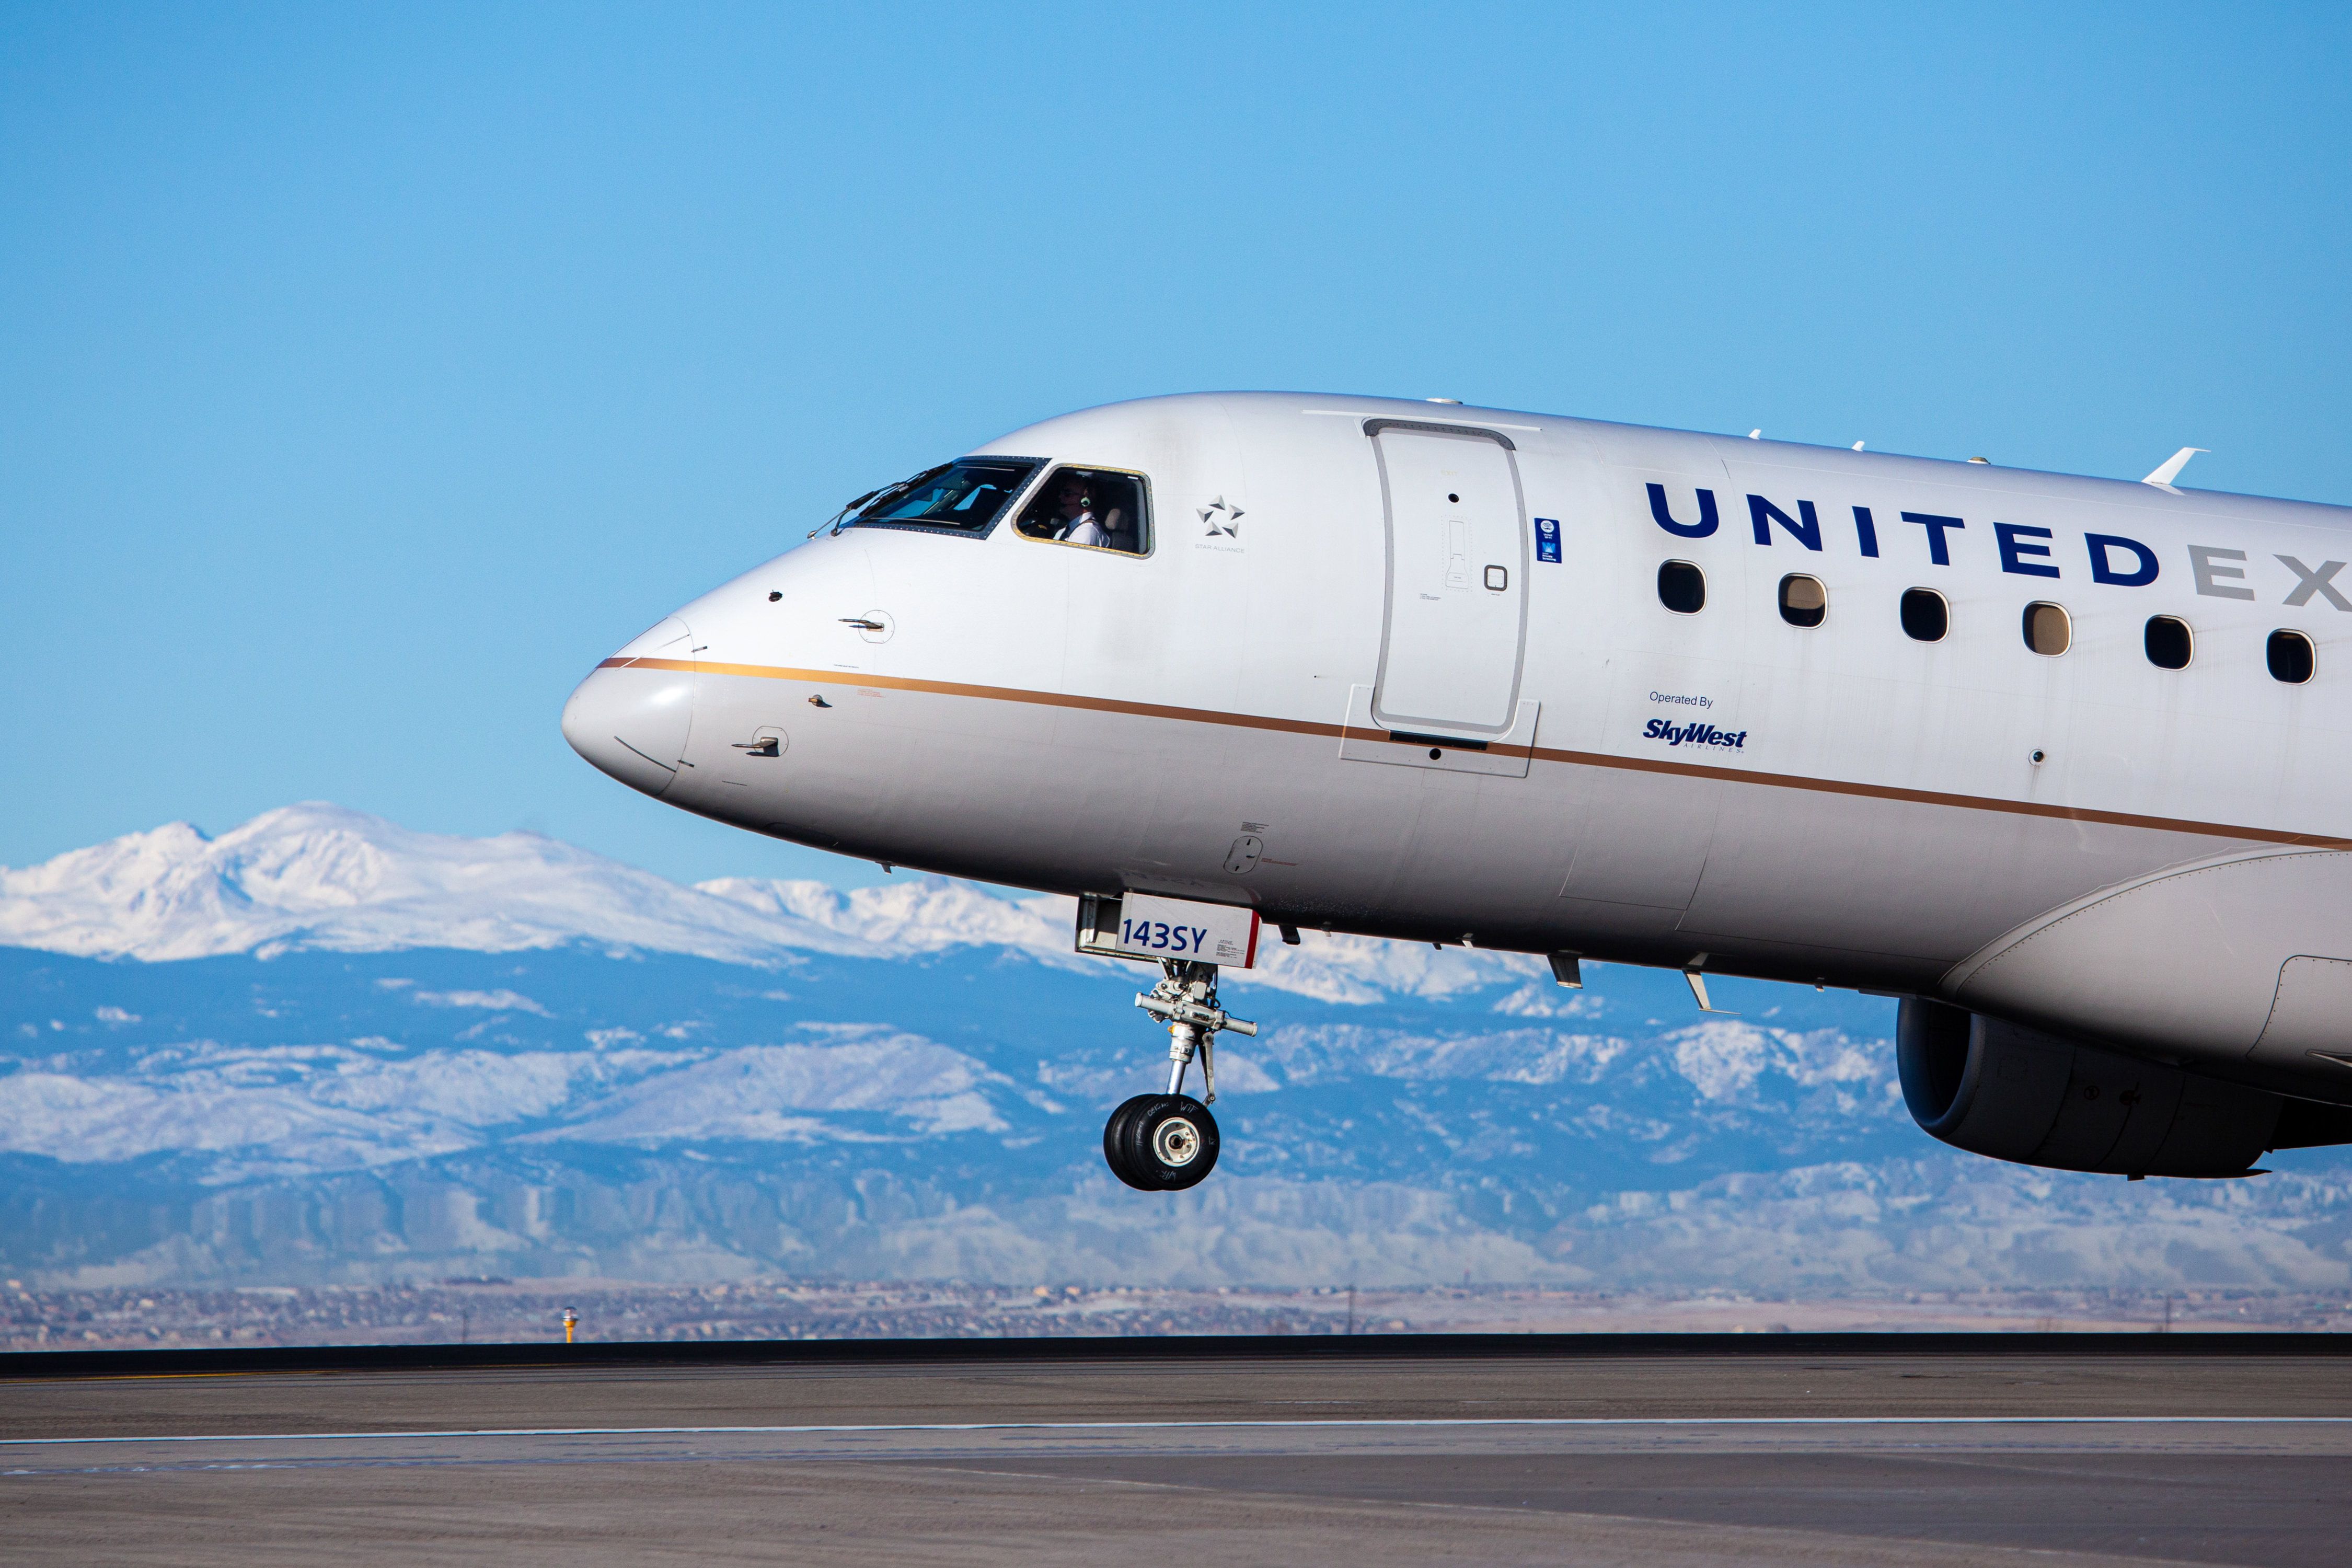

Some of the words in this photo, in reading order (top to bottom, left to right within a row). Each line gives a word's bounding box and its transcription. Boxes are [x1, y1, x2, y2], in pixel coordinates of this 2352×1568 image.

[1646, 483, 2159, 586] UNITED
[2187, 544, 2352, 613] EX
[1650, 691, 1698, 706] Operated
[1700, 697, 1713, 709] By
[1643, 719, 1747, 748] SkyWest
[1684, 743, 1741, 753] AIRLINES
[1123, 918, 1207, 954] 143SY
